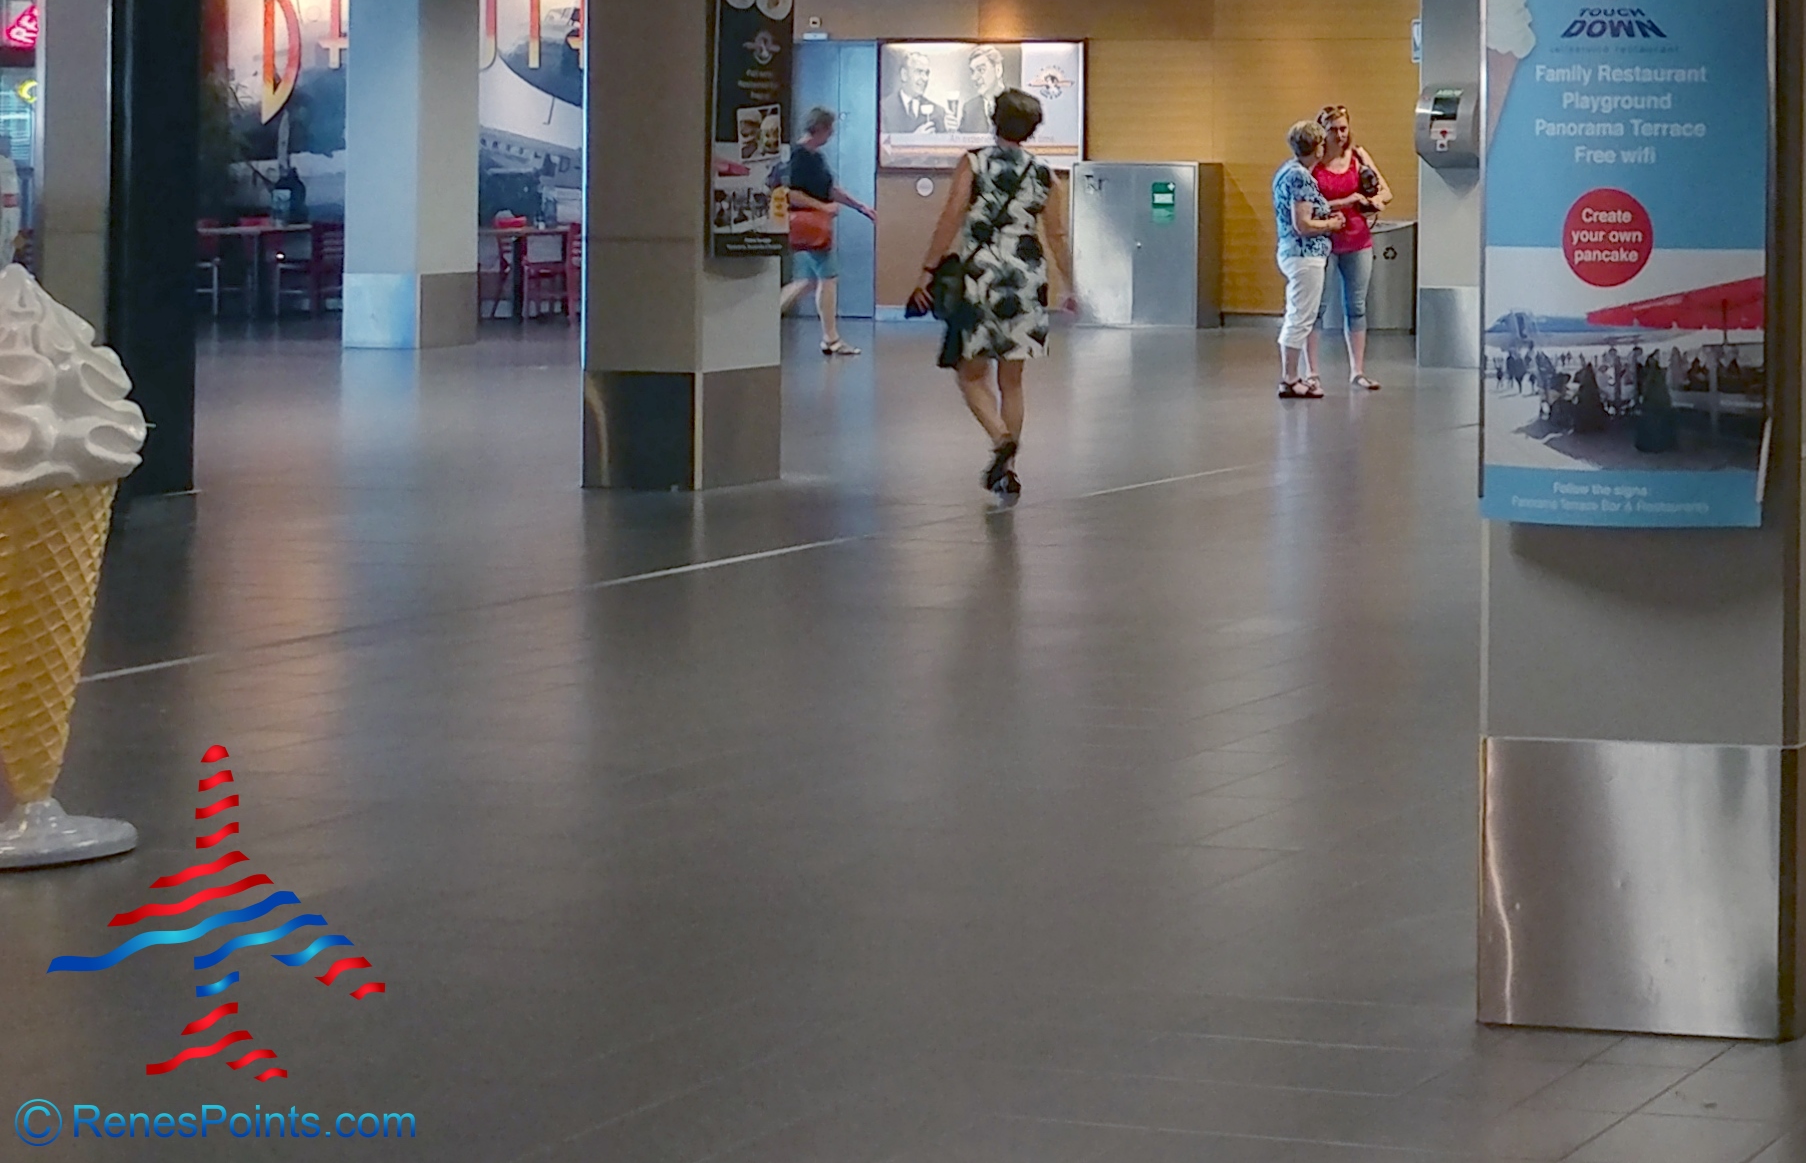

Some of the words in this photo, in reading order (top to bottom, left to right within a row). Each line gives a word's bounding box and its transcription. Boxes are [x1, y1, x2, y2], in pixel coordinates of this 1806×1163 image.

[1579, 7, 1646, 18] TOUCH
[1559, 19, 1668, 39] DOWN
[1535, 65, 1593, 86] Family
[1598, 65, 1708, 83] Restaurant
[1562, 92, 1673, 113] Playground
[1535, 119, 1625, 137] Panorama
[1630, 119, 1707, 138] Terrace
[1574, 145, 1617, 164] Free
[1620, 146, 1656, 164] wifi
[1581, 207, 1633, 224] Create
[1571, 231, 1605, 245] your
[1608, 231, 1642, 243] own
[1574, 247, 1639, 265] pancake
